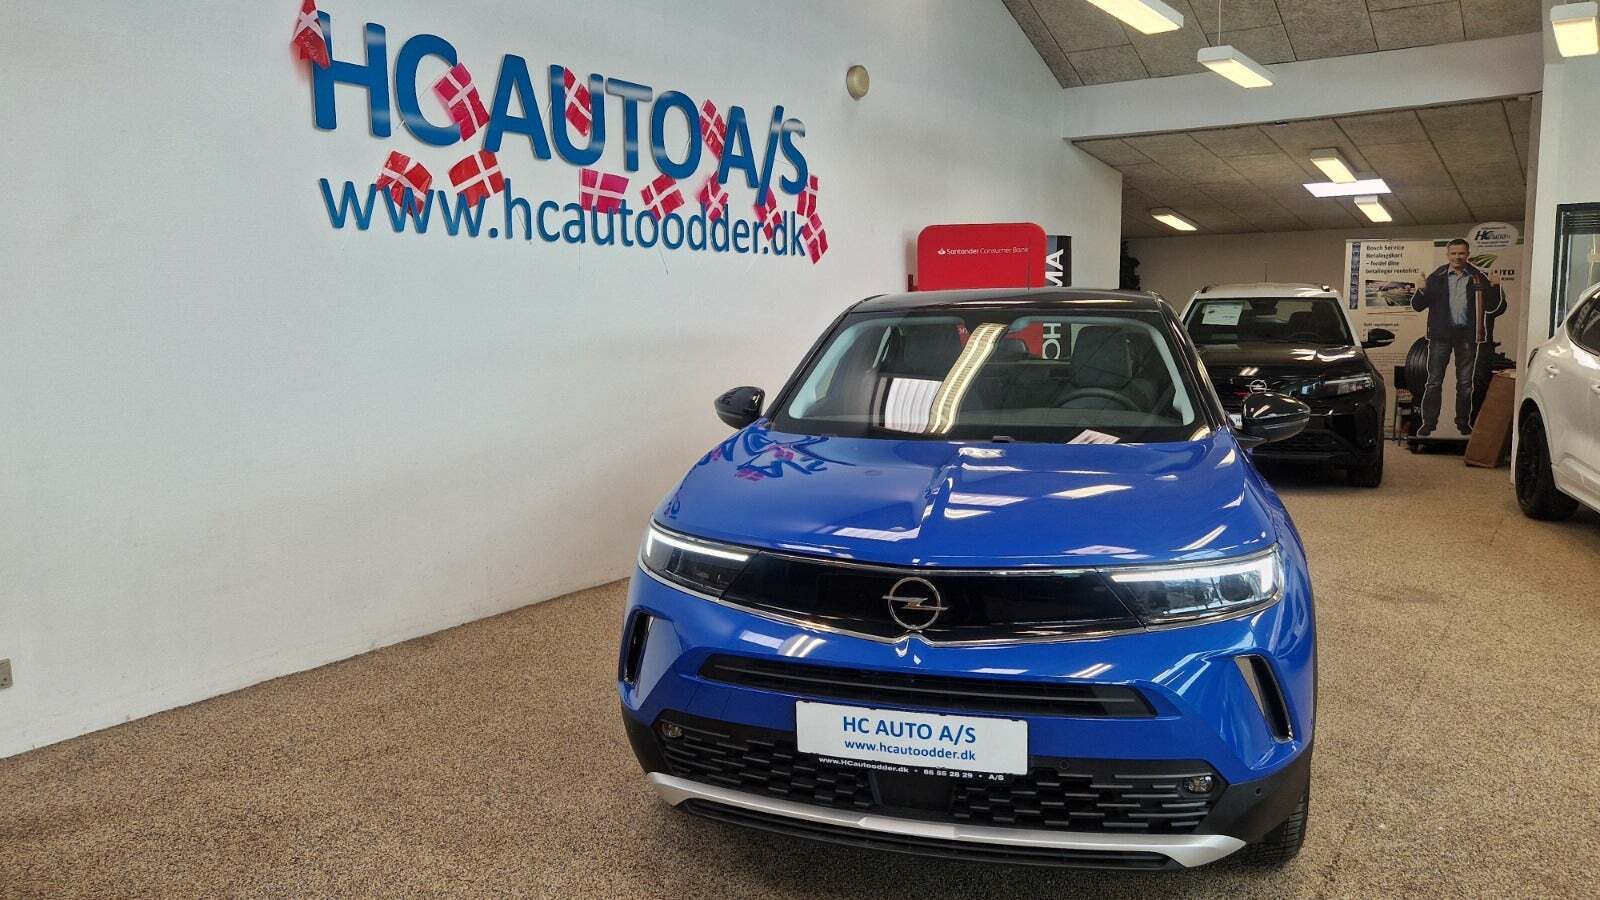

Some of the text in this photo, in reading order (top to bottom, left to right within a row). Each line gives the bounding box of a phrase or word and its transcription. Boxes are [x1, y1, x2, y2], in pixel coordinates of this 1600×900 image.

[312, 10, 809, 205] HC AUTO A/S
[319, 177, 806, 256] www.hcautoodder.dk
[843, 716, 976, 745] HC AUTO A/S
[818, 756, 909, 774] www.HCautoodder.dk
[844, 740, 976, 761] www.hcautoodder.dk
